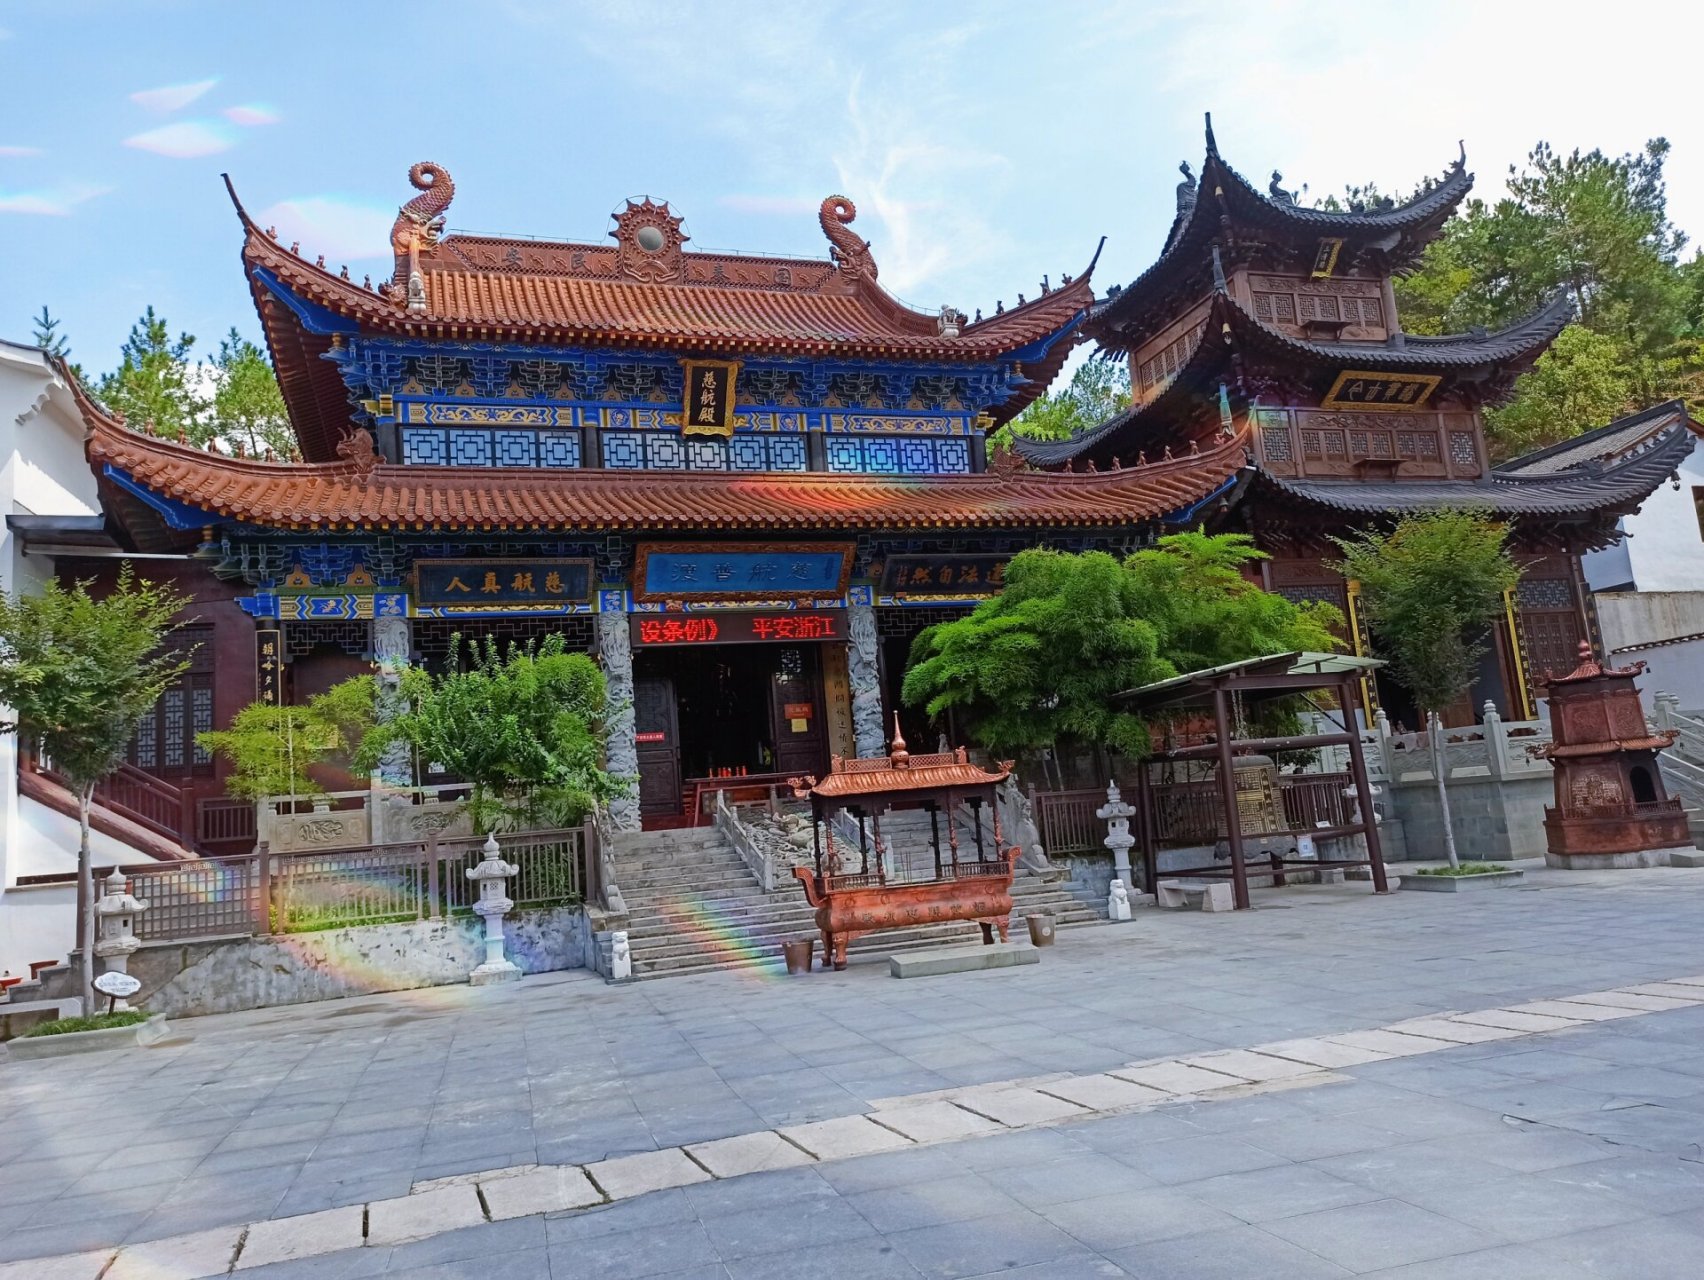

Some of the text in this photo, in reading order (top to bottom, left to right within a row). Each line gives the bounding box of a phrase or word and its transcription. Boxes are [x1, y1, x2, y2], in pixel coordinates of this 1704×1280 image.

[697, 370, 717, 423] 慈航殿
[444, 571, 565, 594] 慈航真人
[752, 616, 836, 640] 平安浙江
